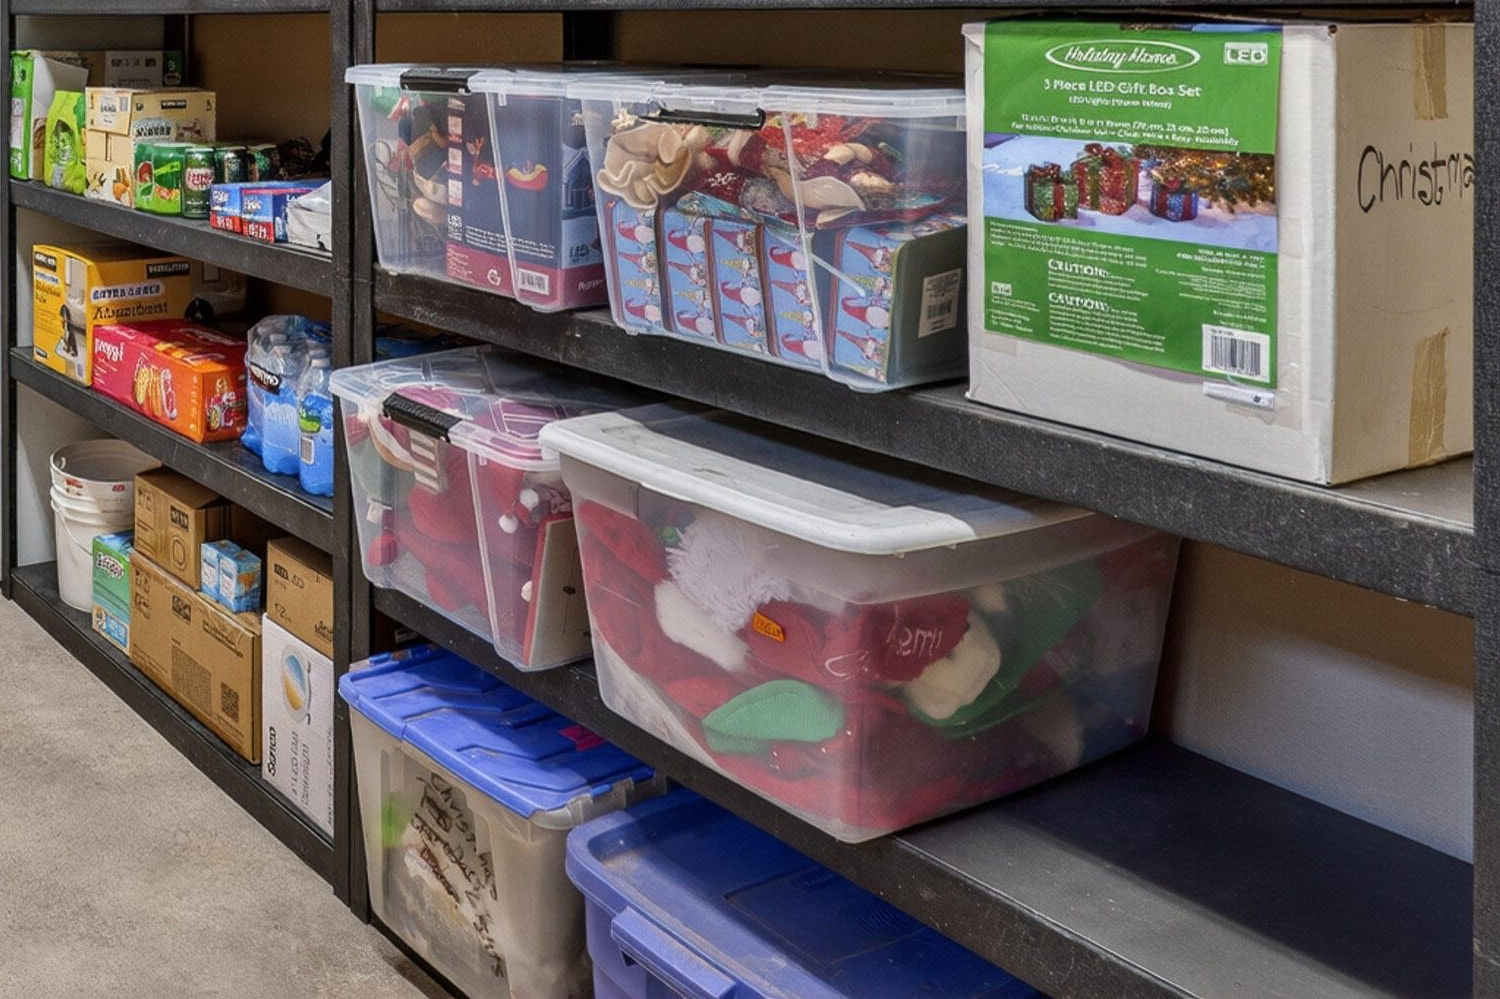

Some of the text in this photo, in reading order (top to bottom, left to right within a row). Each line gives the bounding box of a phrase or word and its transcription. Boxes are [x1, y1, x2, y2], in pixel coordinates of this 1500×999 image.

[1089, 80, 1115, 93] LED
[1177, 85, 1202, 97] Set
[1357, 141, 1475, 214] Christma
